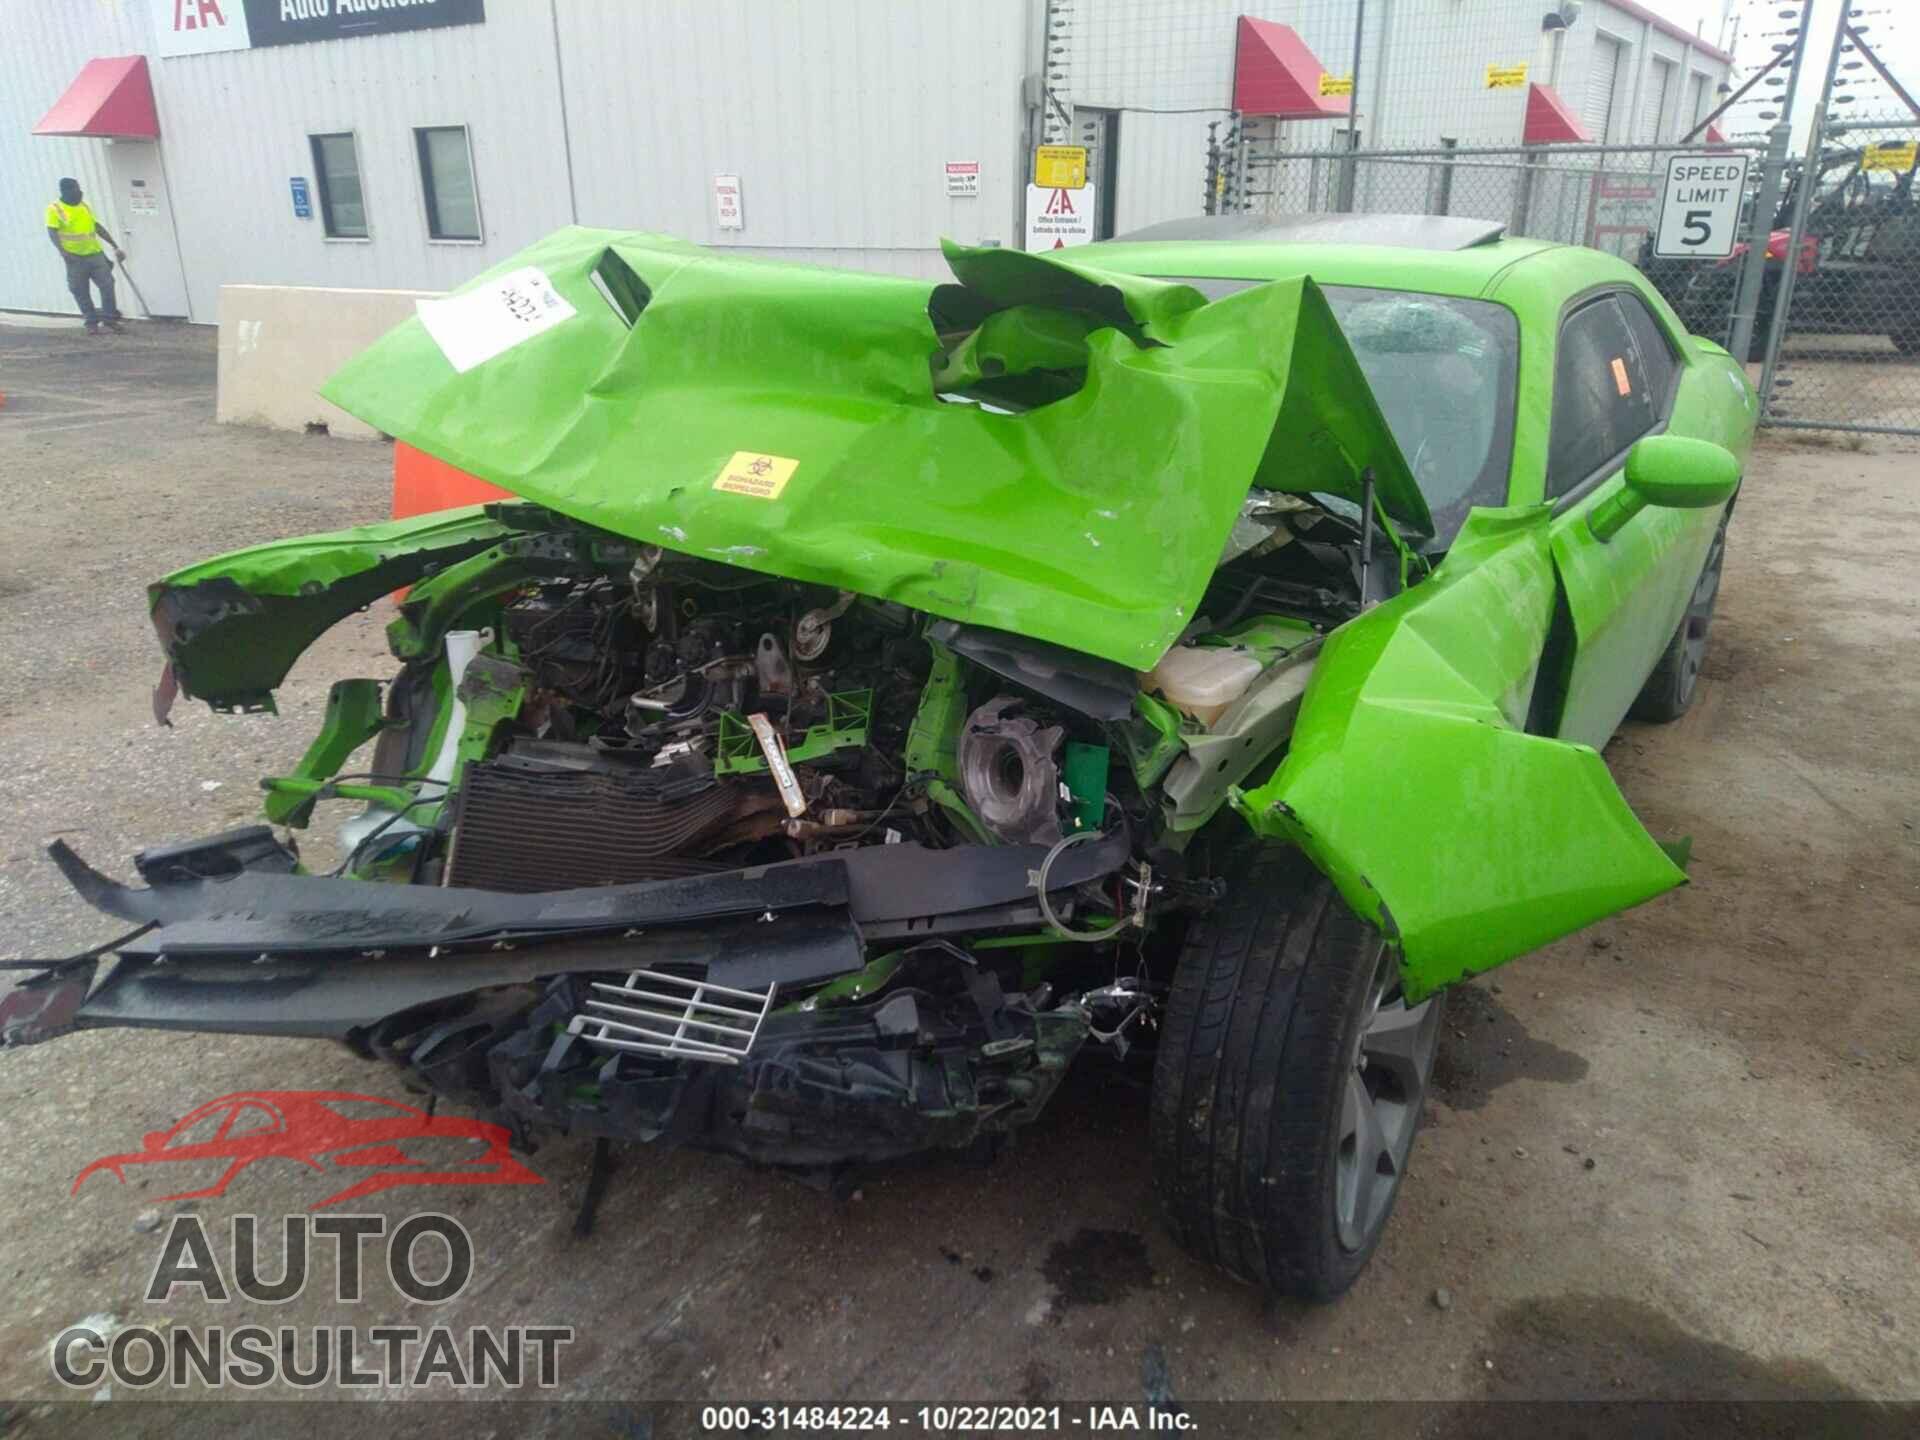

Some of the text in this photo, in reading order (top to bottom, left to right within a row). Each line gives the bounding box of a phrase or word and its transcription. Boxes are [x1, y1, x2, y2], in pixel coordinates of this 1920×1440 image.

[1673, 166, 1740, 181] SPEED
[1676, 188, 1729, 203] LIMIT
[1680, 210, 1713, 246] 5
